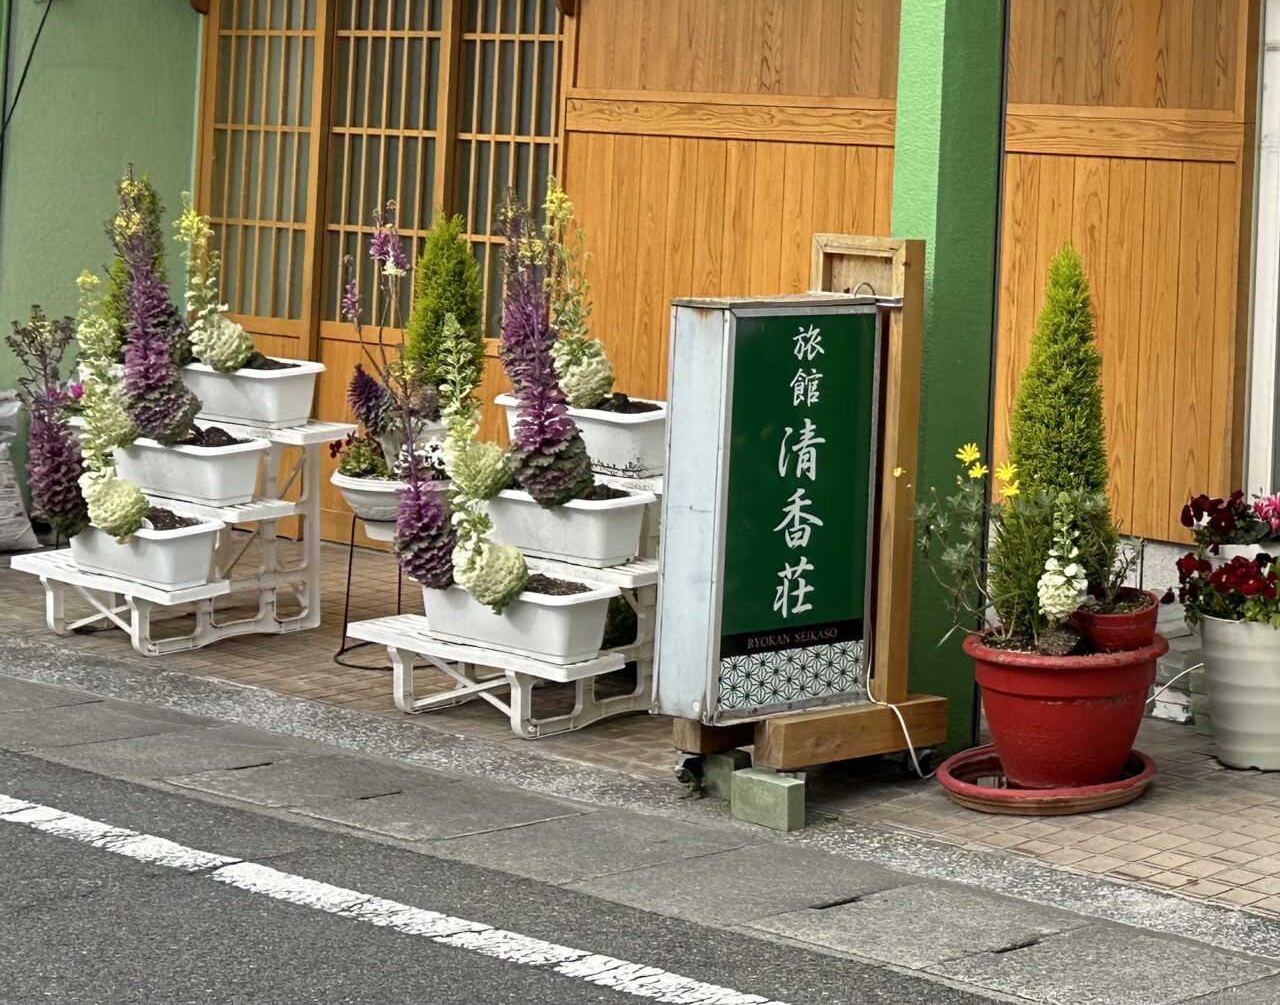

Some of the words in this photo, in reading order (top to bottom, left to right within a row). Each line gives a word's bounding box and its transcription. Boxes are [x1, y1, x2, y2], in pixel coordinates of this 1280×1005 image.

[789, 323, 826, 408] 旅館
[773, 417, 826, 619] 清香荘
[747, 634, 791, 650] RYOKAN
[794, 627, 838, 643] SEIKASO
